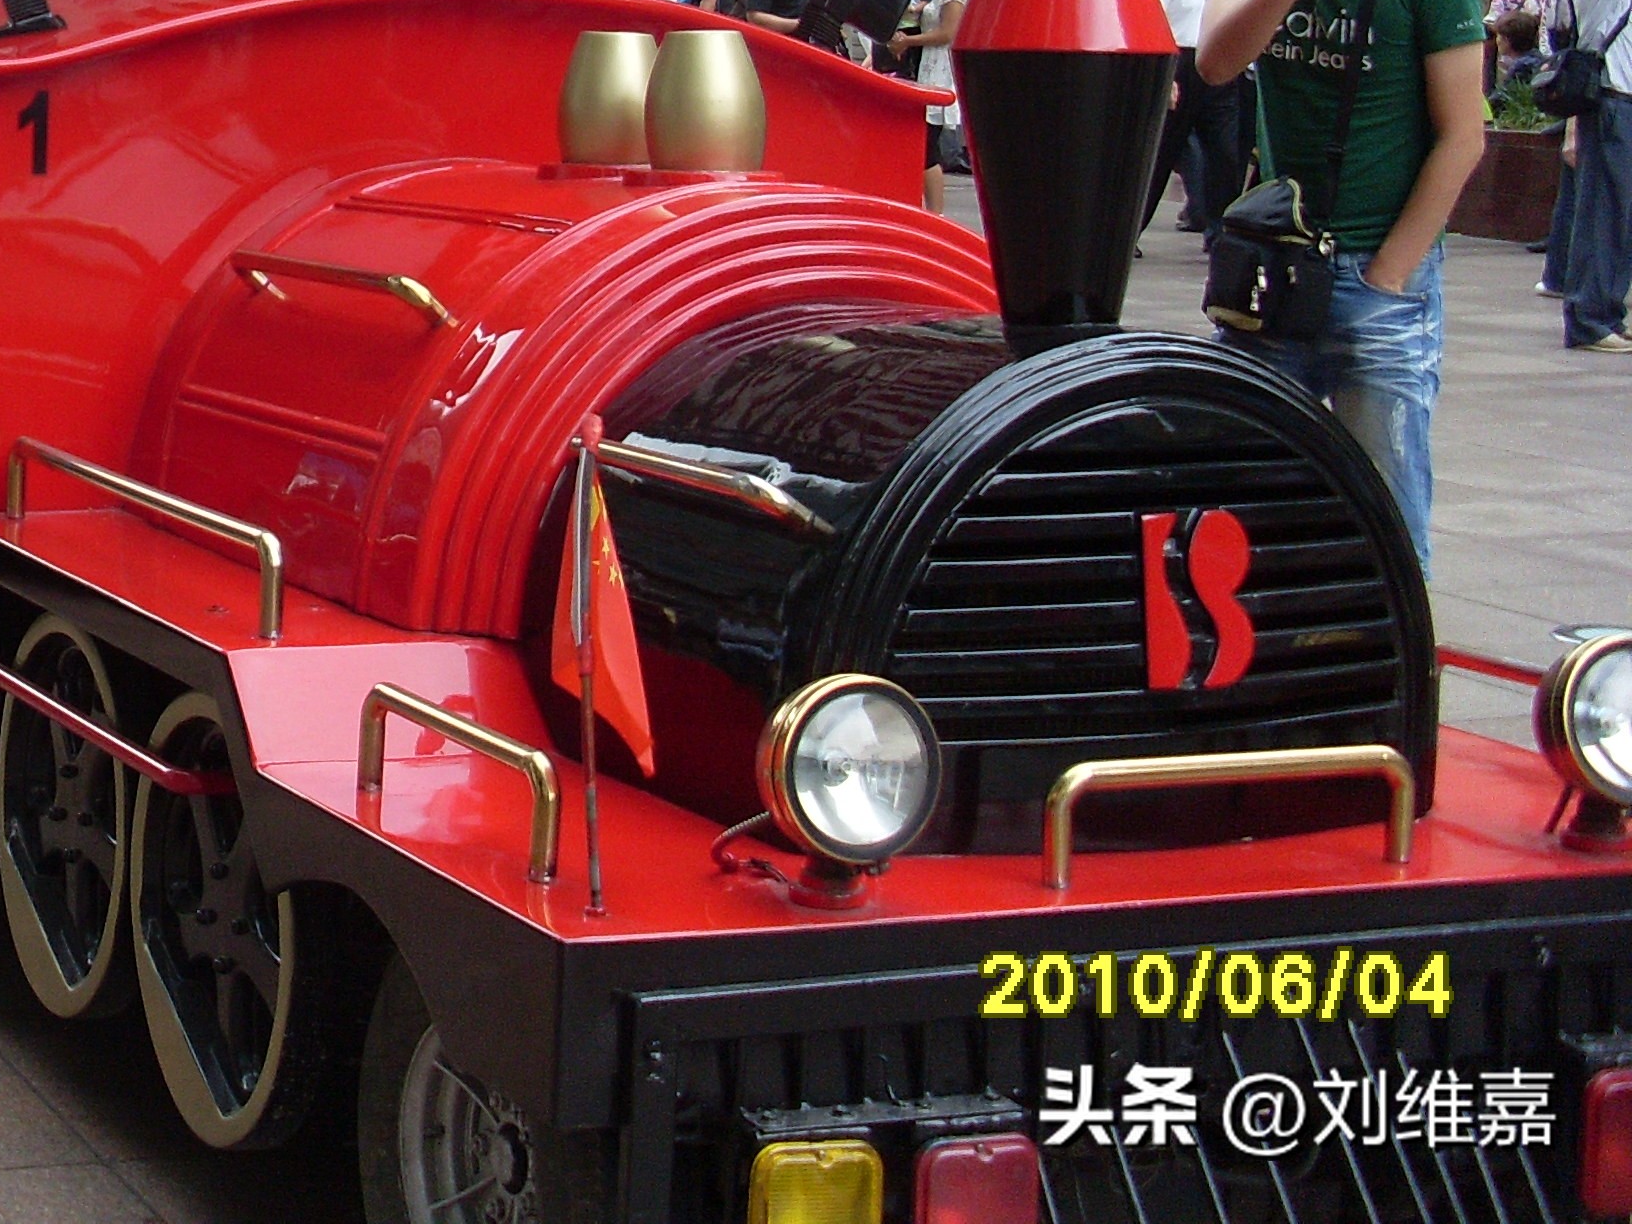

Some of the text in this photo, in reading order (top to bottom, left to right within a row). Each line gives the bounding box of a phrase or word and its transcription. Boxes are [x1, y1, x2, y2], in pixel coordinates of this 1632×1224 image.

[1276, 8, 1375, 45] alvin
[1308, 45, 1373, 72] Jeas
[16, 90, 50, 176] 1
